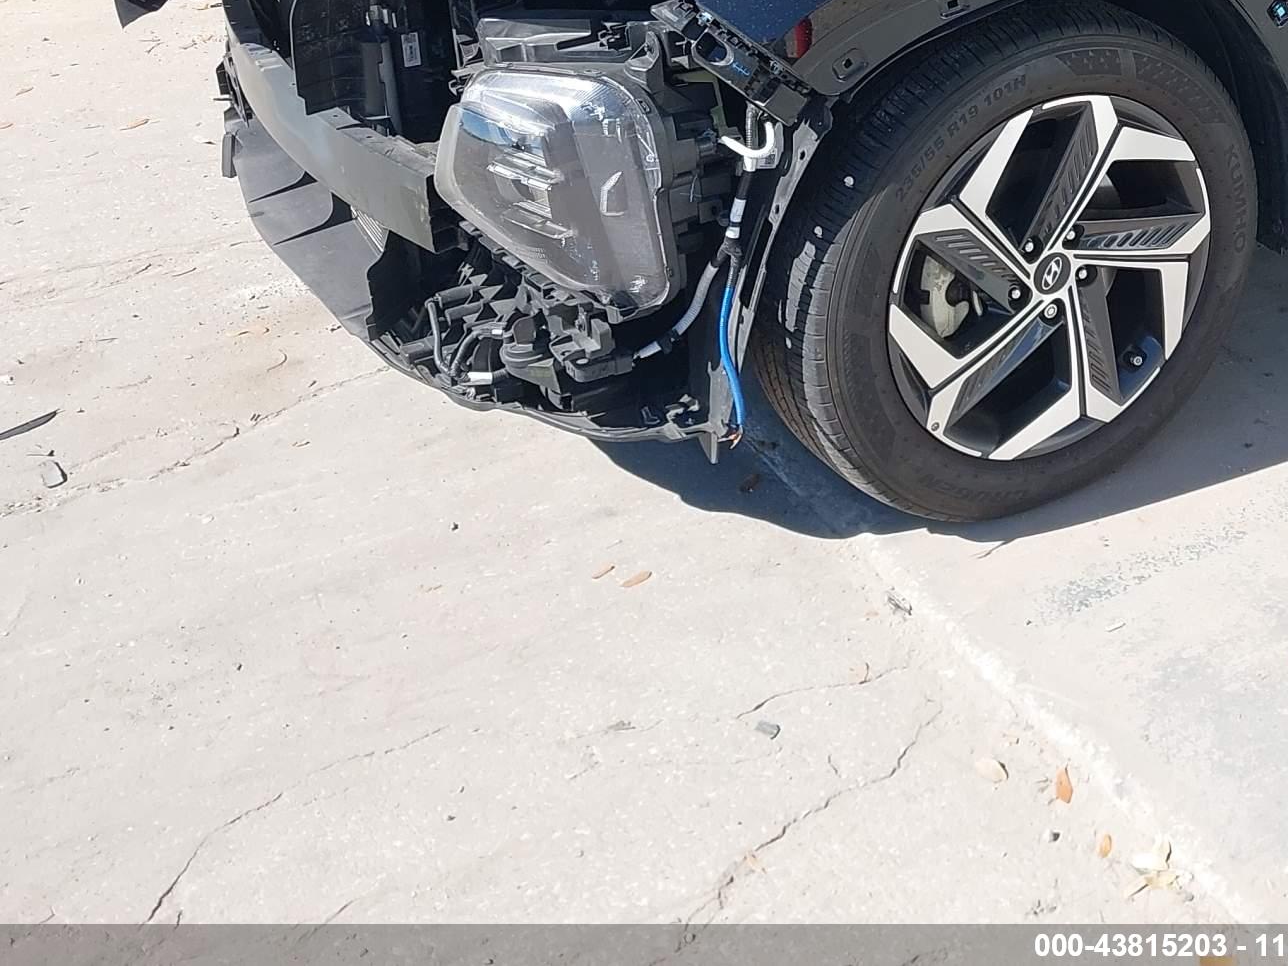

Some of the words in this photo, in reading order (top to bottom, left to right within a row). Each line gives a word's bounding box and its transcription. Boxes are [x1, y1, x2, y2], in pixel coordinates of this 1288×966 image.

[946, 104, 979, 139] R19
[983, 74, 1027, 107] 101H
[1223, 143, 1249, 254] KUMHO
